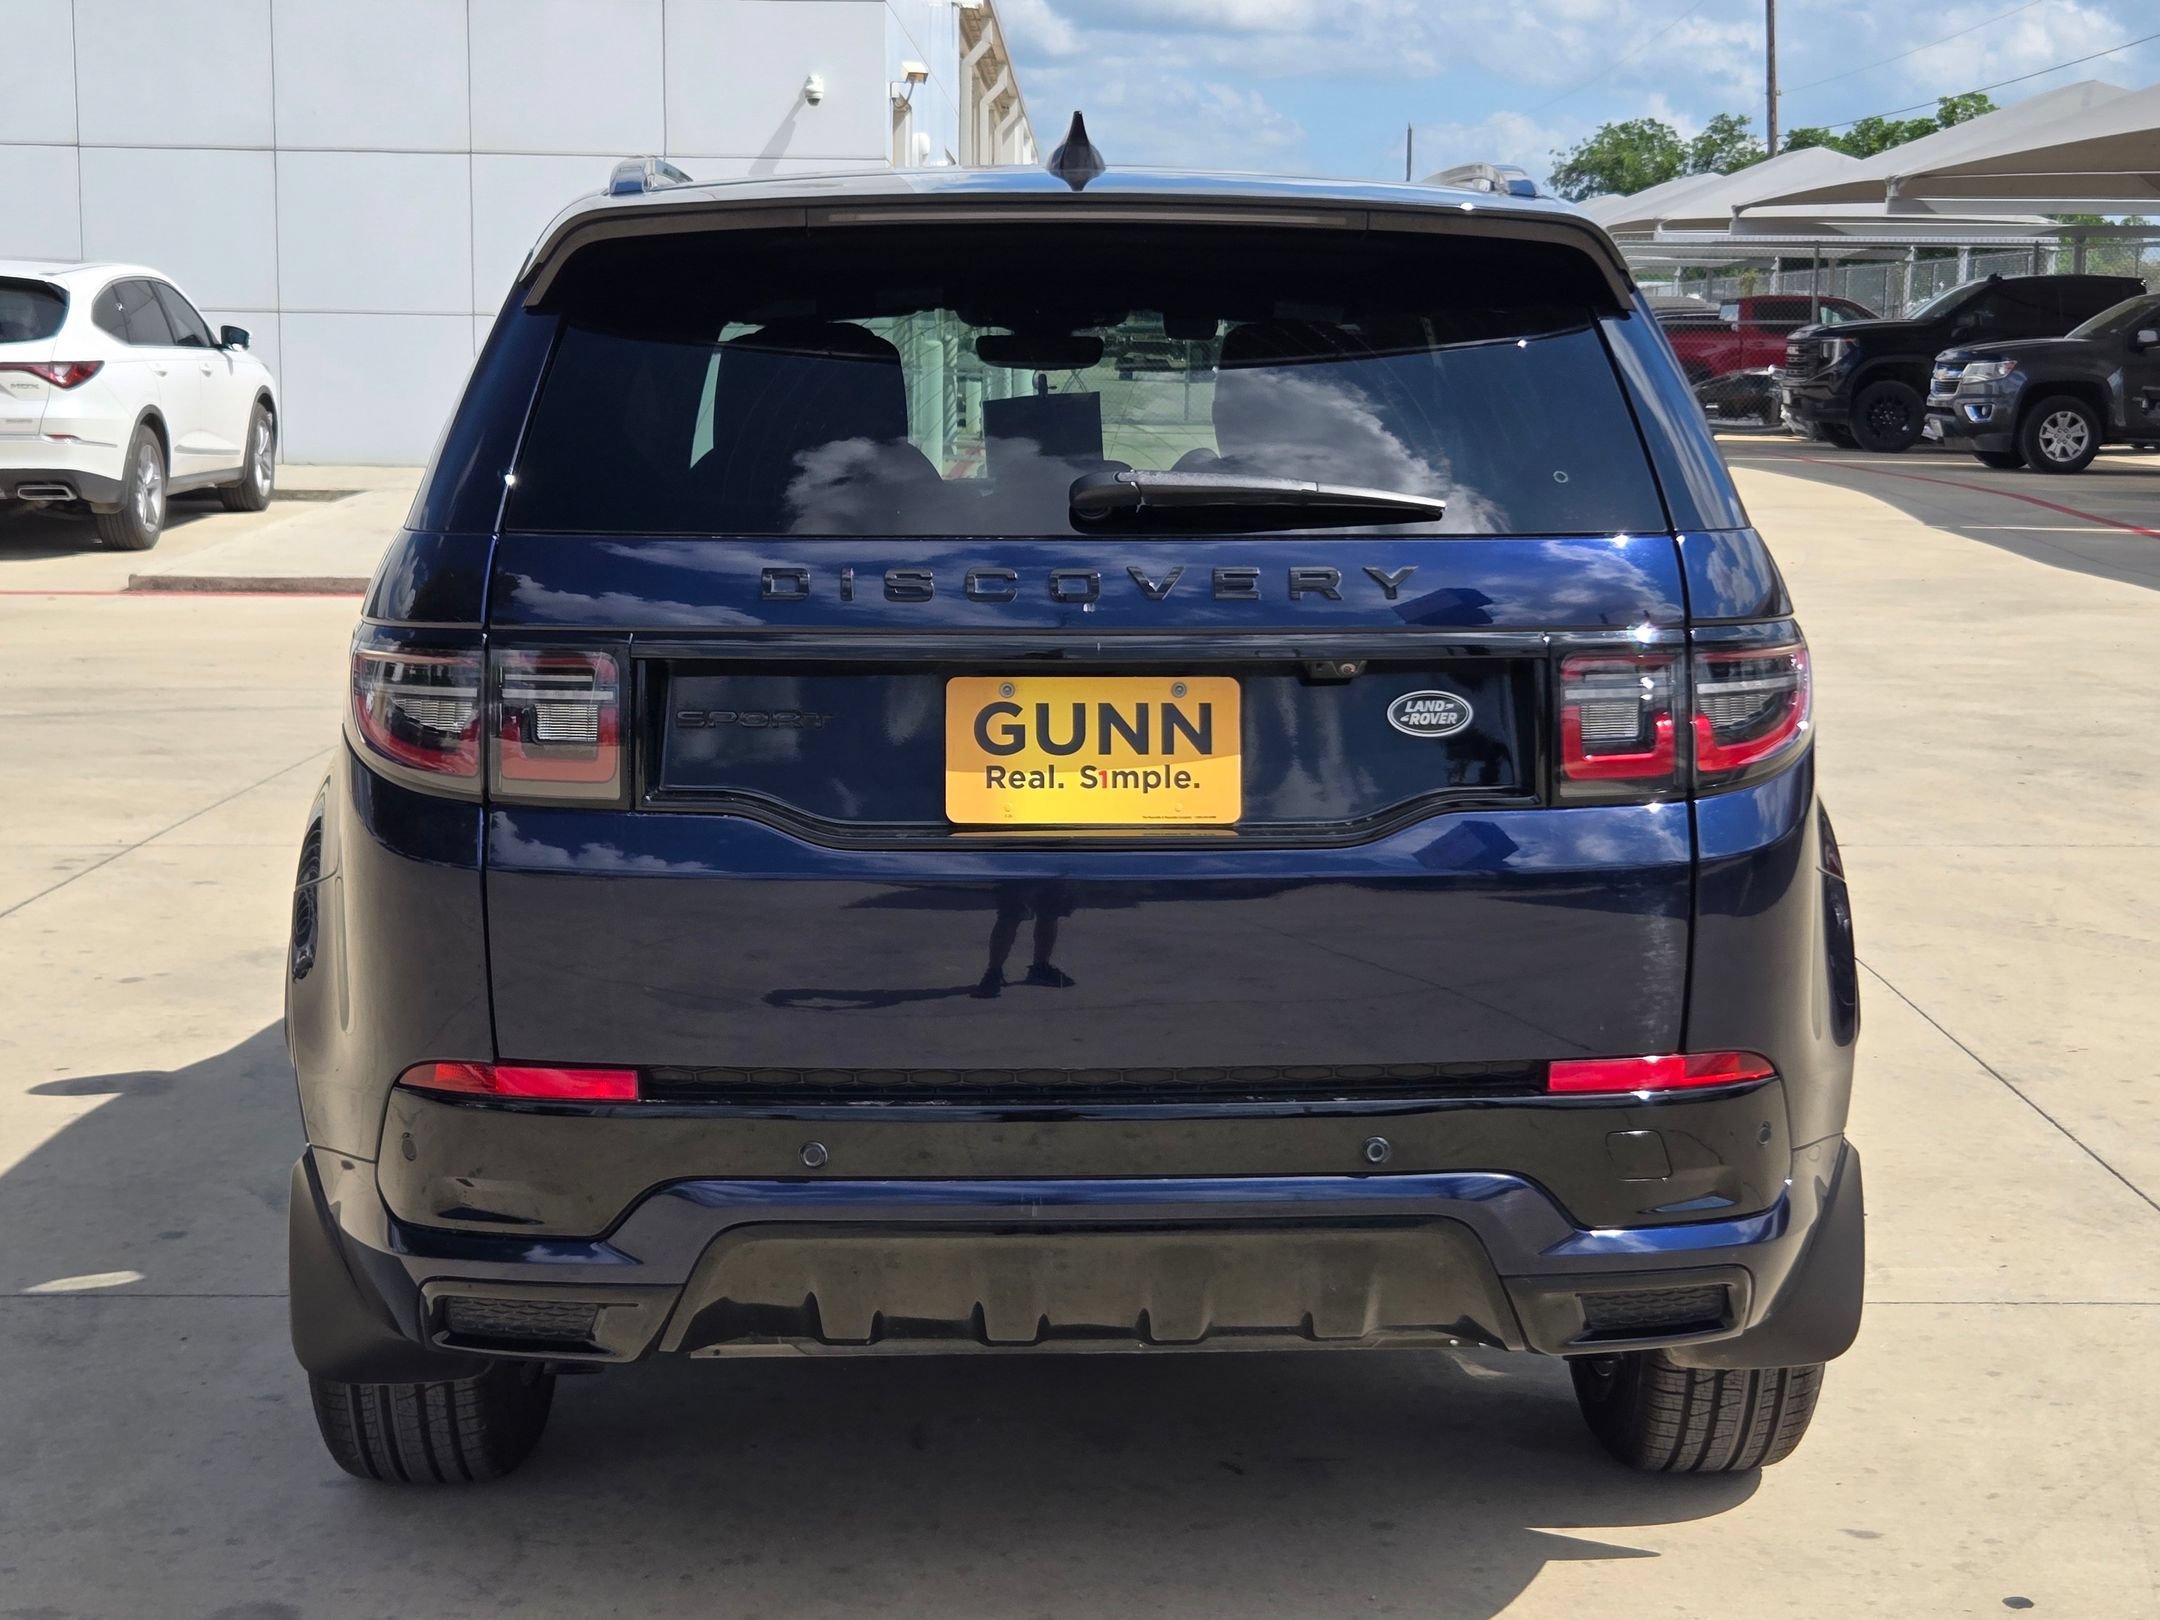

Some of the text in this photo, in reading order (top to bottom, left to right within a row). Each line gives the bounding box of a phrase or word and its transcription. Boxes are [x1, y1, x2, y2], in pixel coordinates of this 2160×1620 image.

[761, 565, 1418, 602] DISCOVERY
[1404, 700, 1445, 713] LAND
[1408, 712, 1458, 725] ROVER
[675, 710, 832, 729] SPORT
[973, 701, 1213, 756] GUNN
[985, 764, 1200, 794] Real. S1mple.
